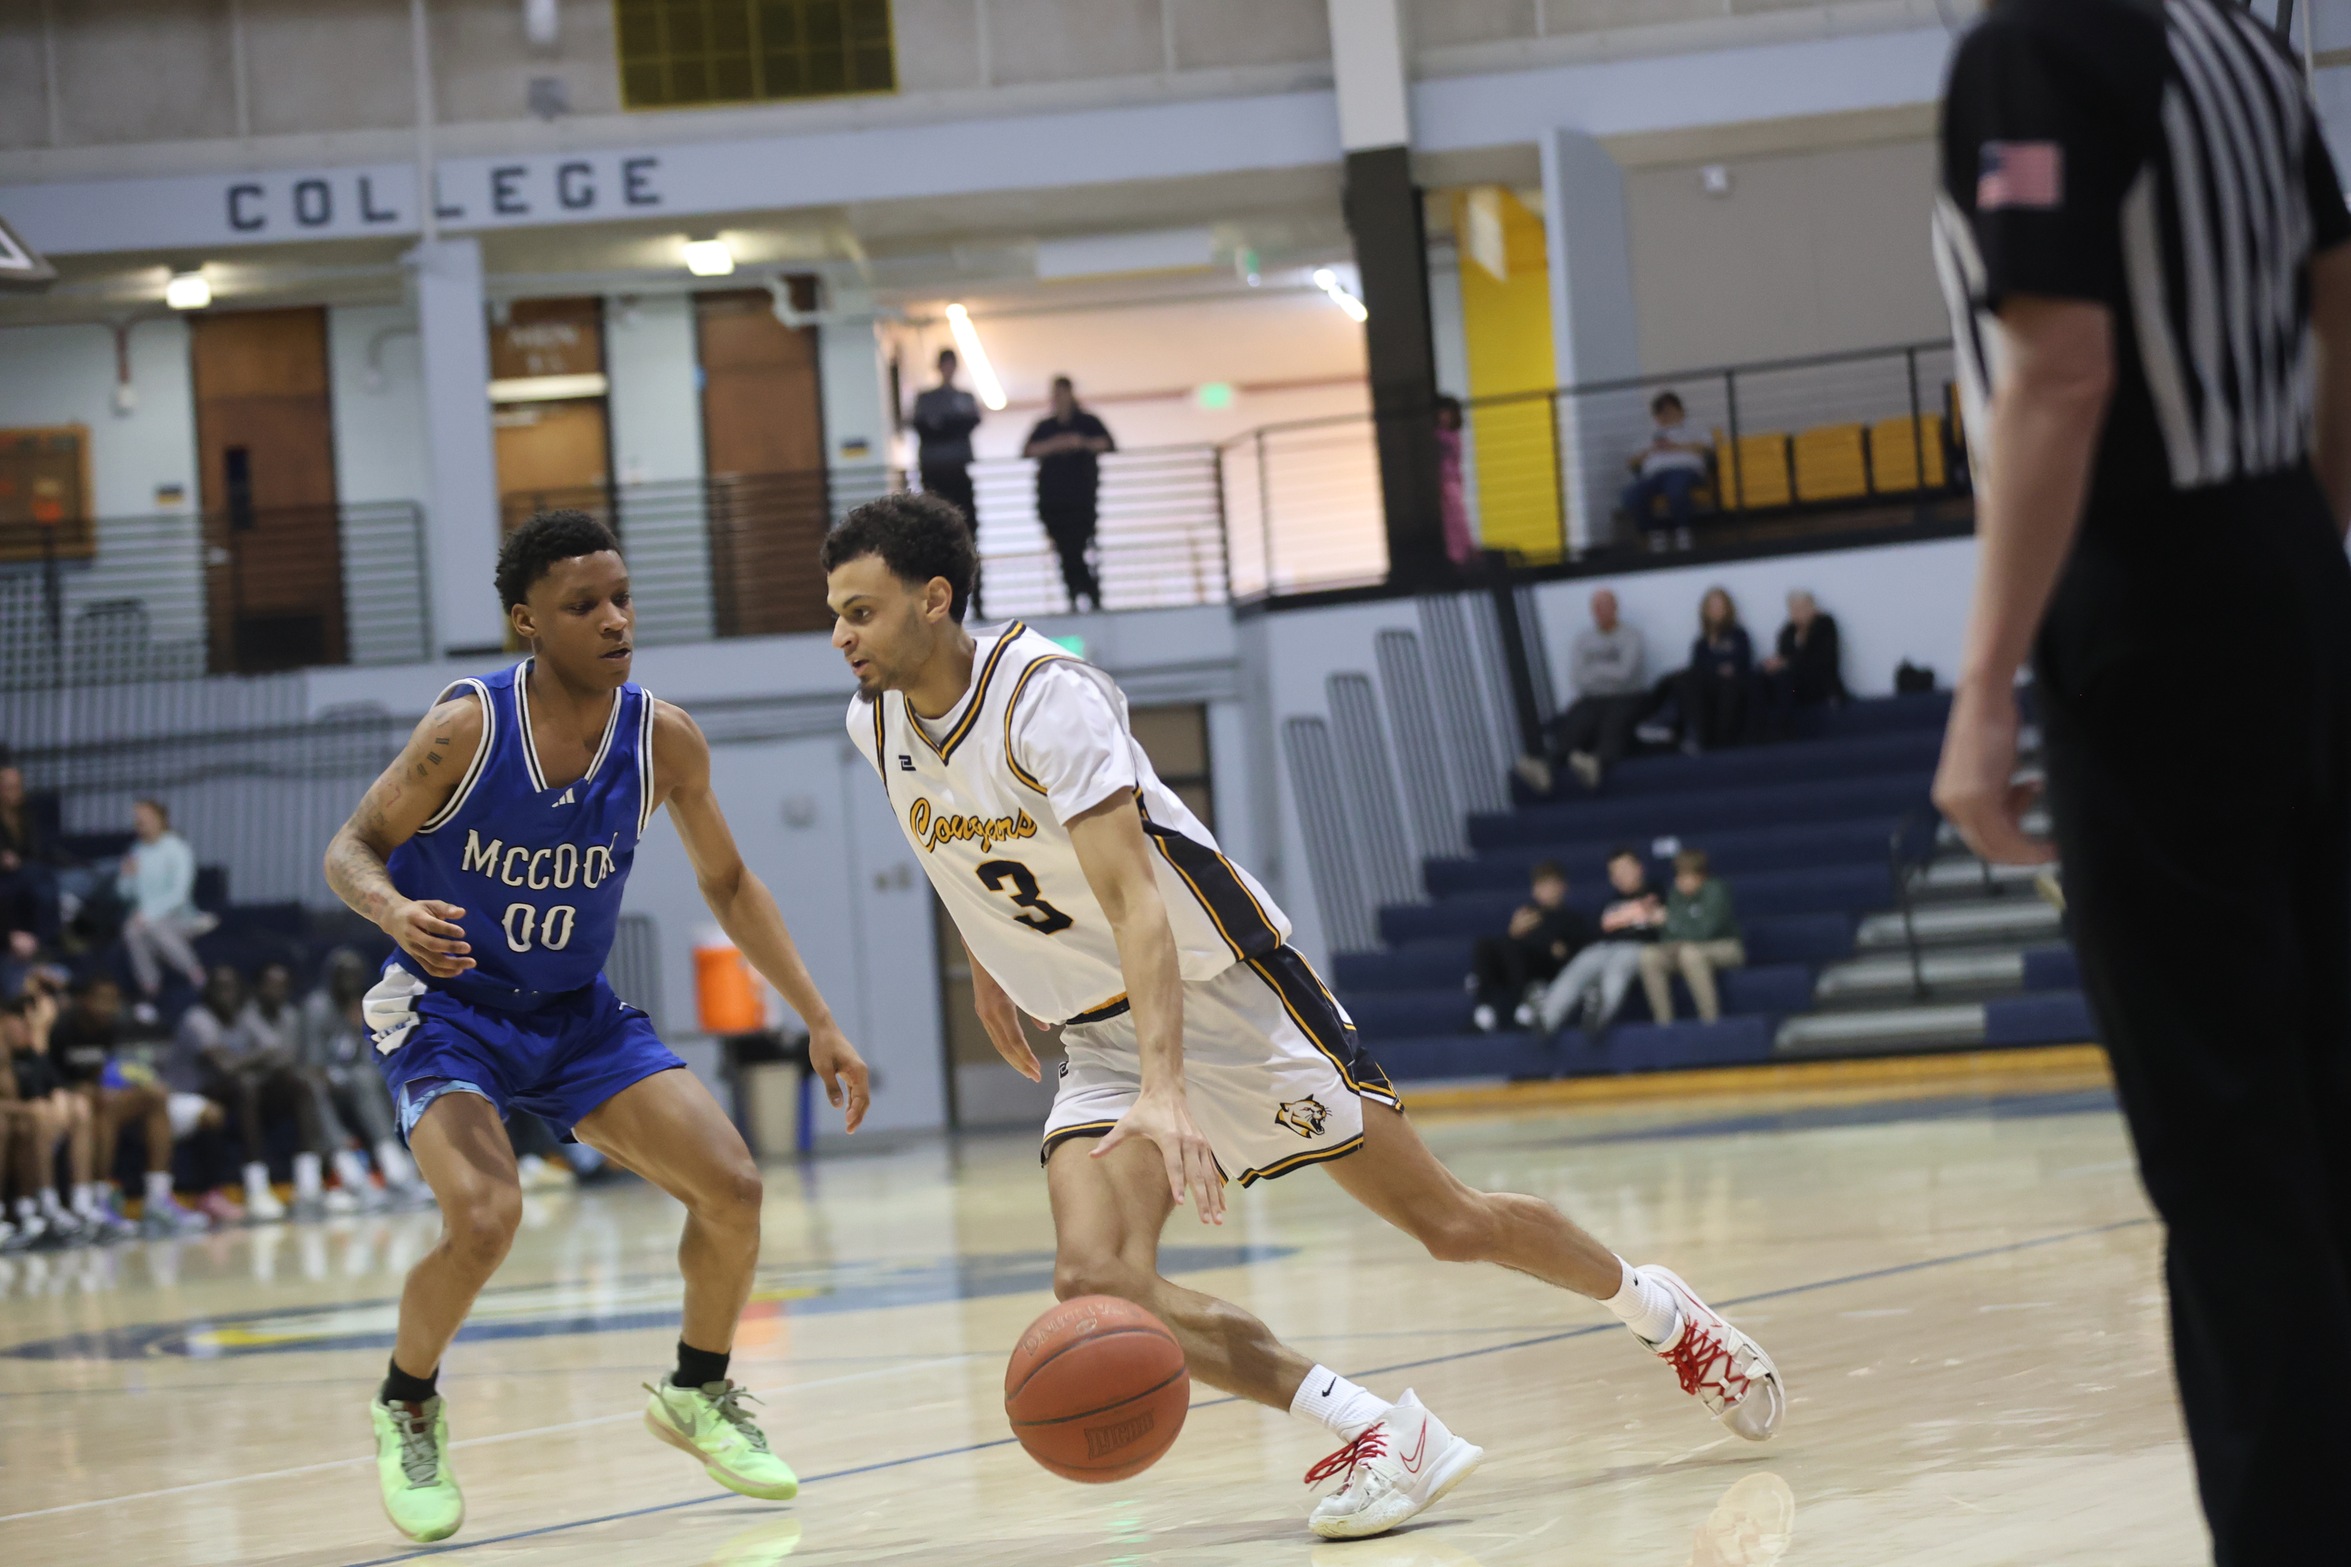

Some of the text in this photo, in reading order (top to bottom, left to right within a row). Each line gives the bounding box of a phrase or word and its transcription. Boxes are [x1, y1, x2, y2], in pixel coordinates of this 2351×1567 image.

[227, 157, 660, 233] COLLEGE
[909, 797, 1037, 853] Cougars
[501, 902, 576, 953] 00
[975, 859, 1074, 935] 3
